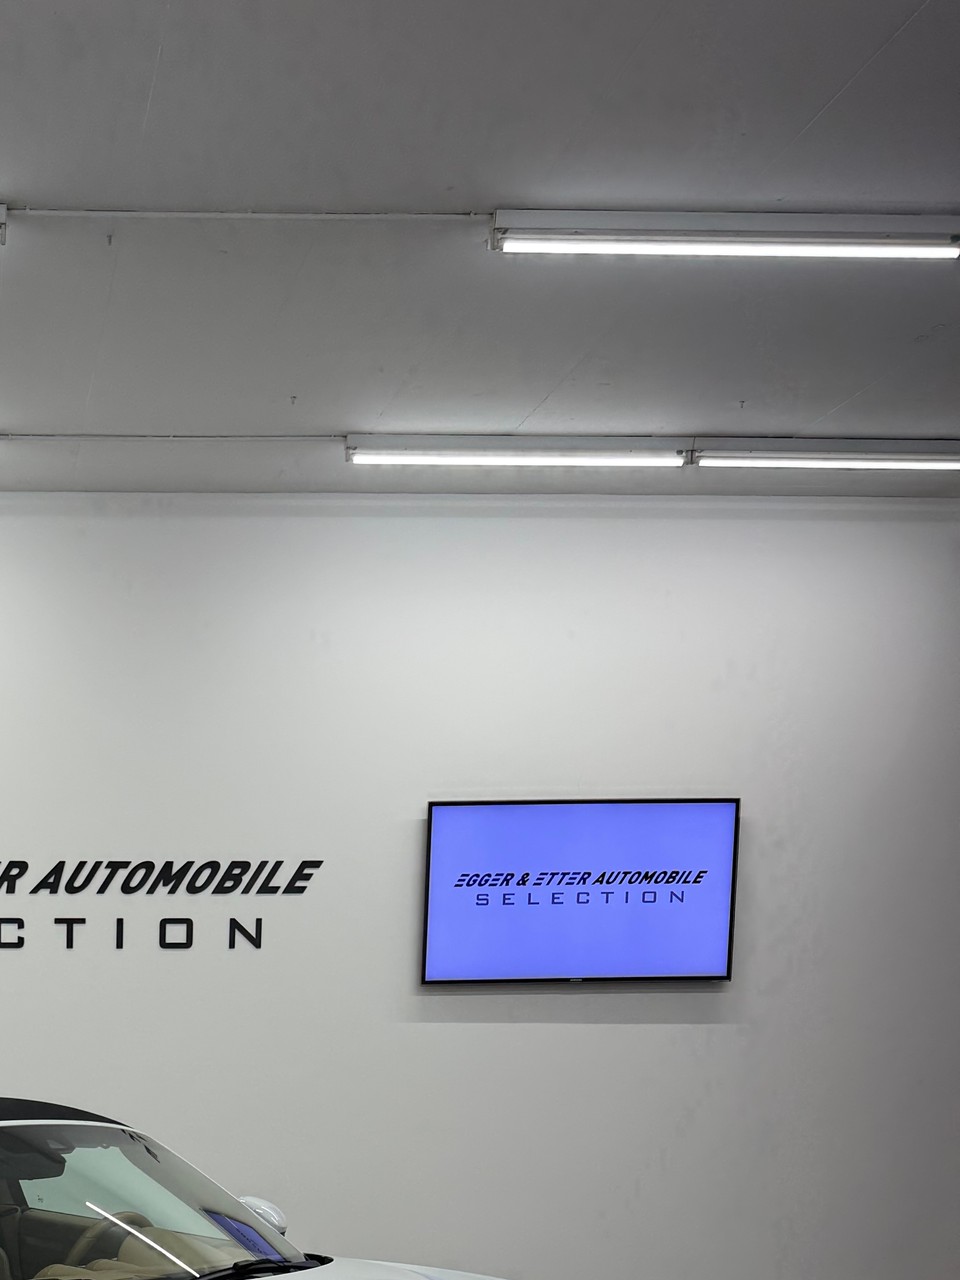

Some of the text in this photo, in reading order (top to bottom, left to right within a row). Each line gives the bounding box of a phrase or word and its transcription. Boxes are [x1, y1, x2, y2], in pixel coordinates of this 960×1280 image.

[29, 860, 323, 895] AUTOMOBILE
[454, 870, 708, 888] EGGER & ETTER AUTOMOBILE
[476, 890, 685, 907] SELECTION
